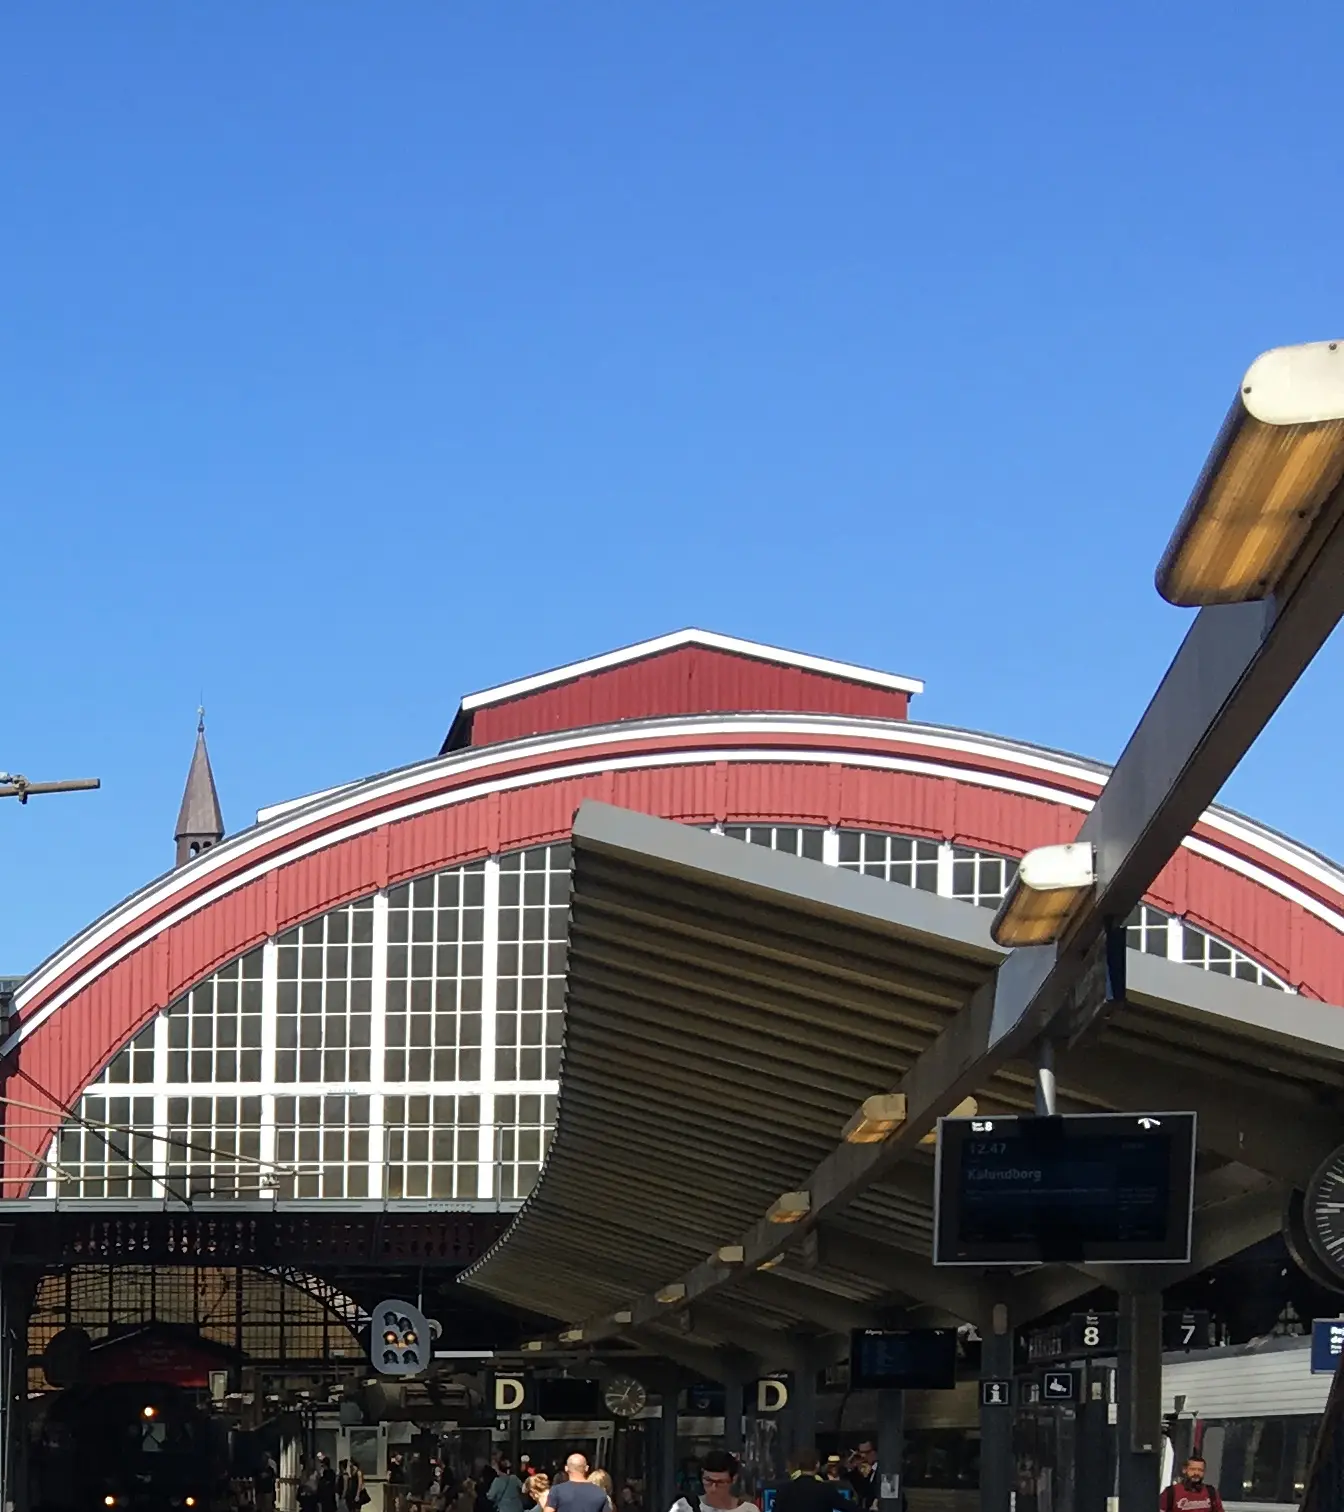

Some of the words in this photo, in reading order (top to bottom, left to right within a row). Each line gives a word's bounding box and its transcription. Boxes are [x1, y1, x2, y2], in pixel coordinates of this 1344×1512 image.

[967, 1169, 1042, 1182] Kalundborg
[1084, 1327, 1100, 1346] 8
[1180, 1325, 1196, 1345] 7
[495, 1379, 525, 1410] D
[757, 1380, 788, 1411] D
